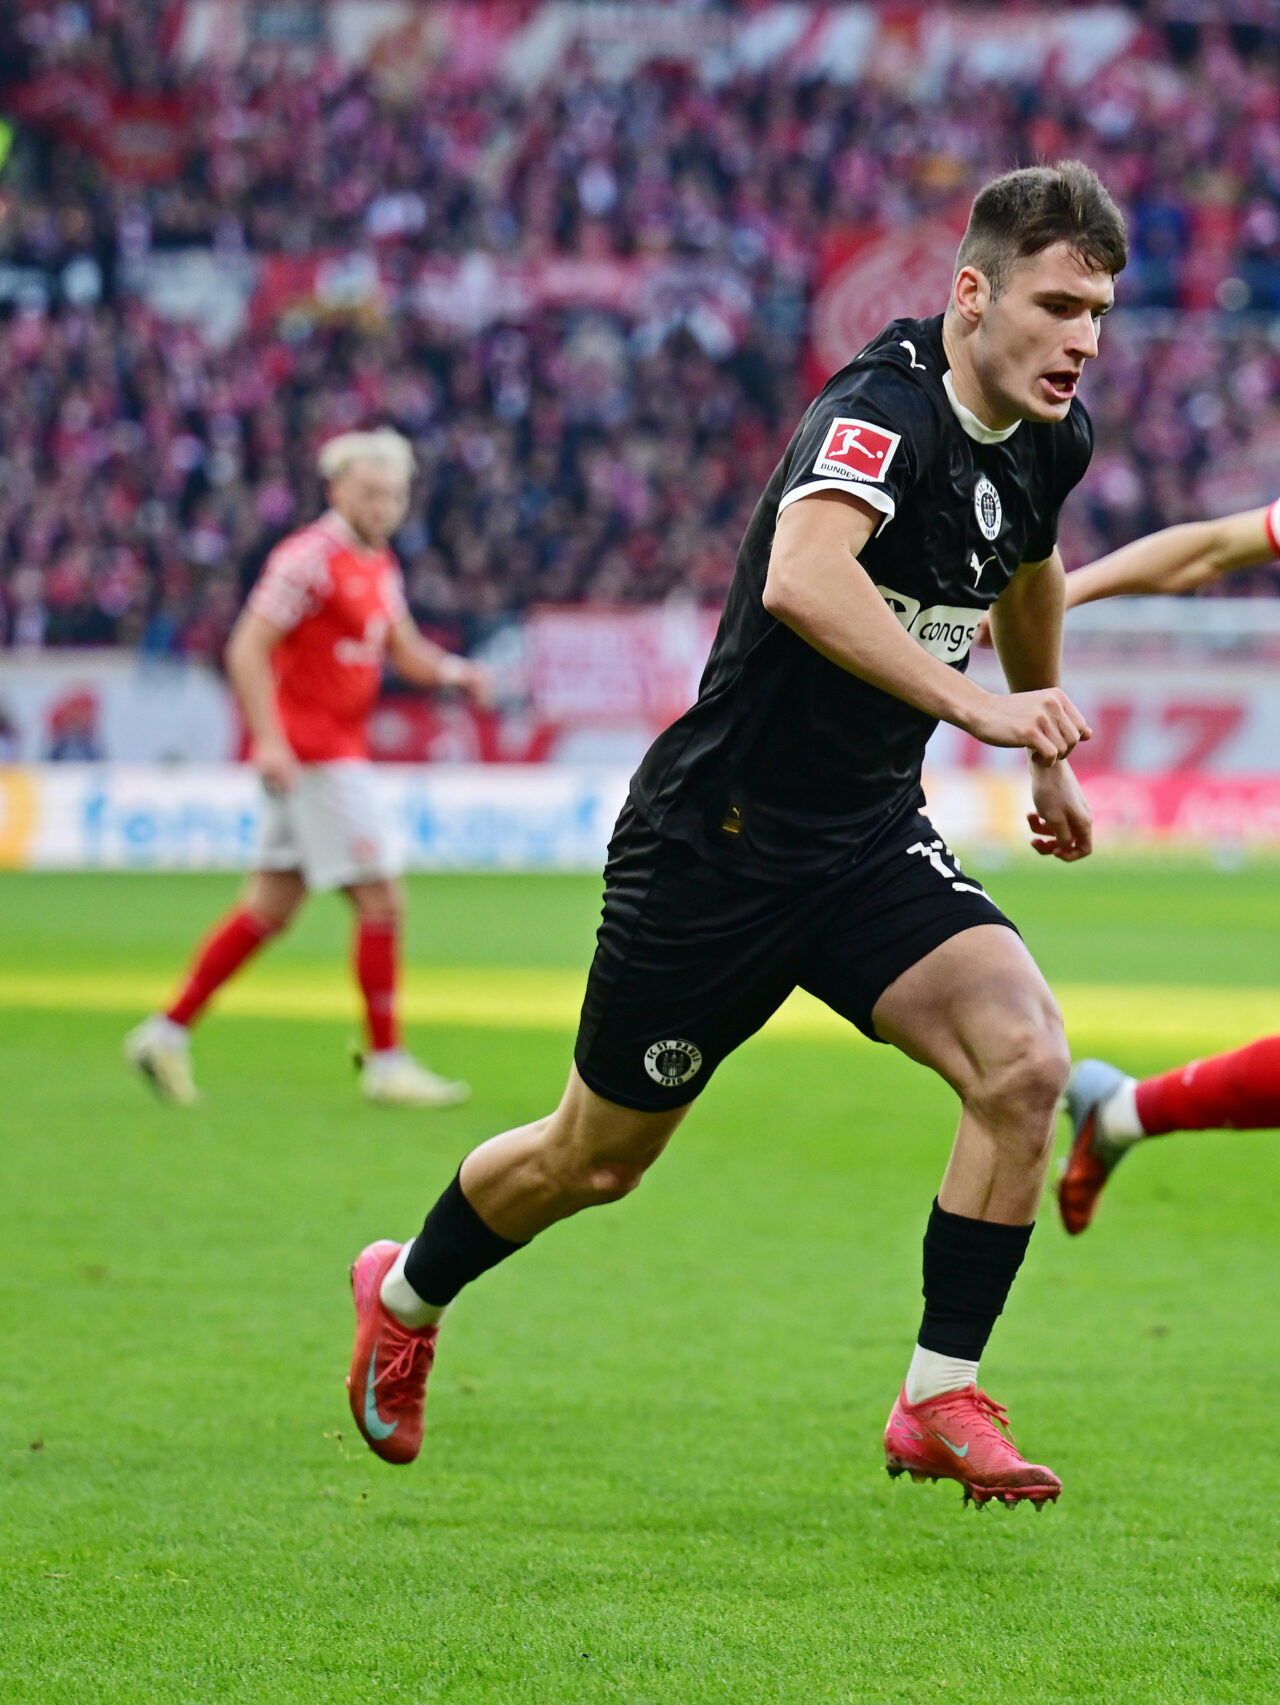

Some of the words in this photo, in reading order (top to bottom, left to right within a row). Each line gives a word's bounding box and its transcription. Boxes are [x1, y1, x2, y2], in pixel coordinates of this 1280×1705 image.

[919, 622, 981, 652] congs
[646, 1048, 658, 1060] FC
[675, 1041, 701, 1062] PAULI
[660, 1077, 684, 1086] 1910
